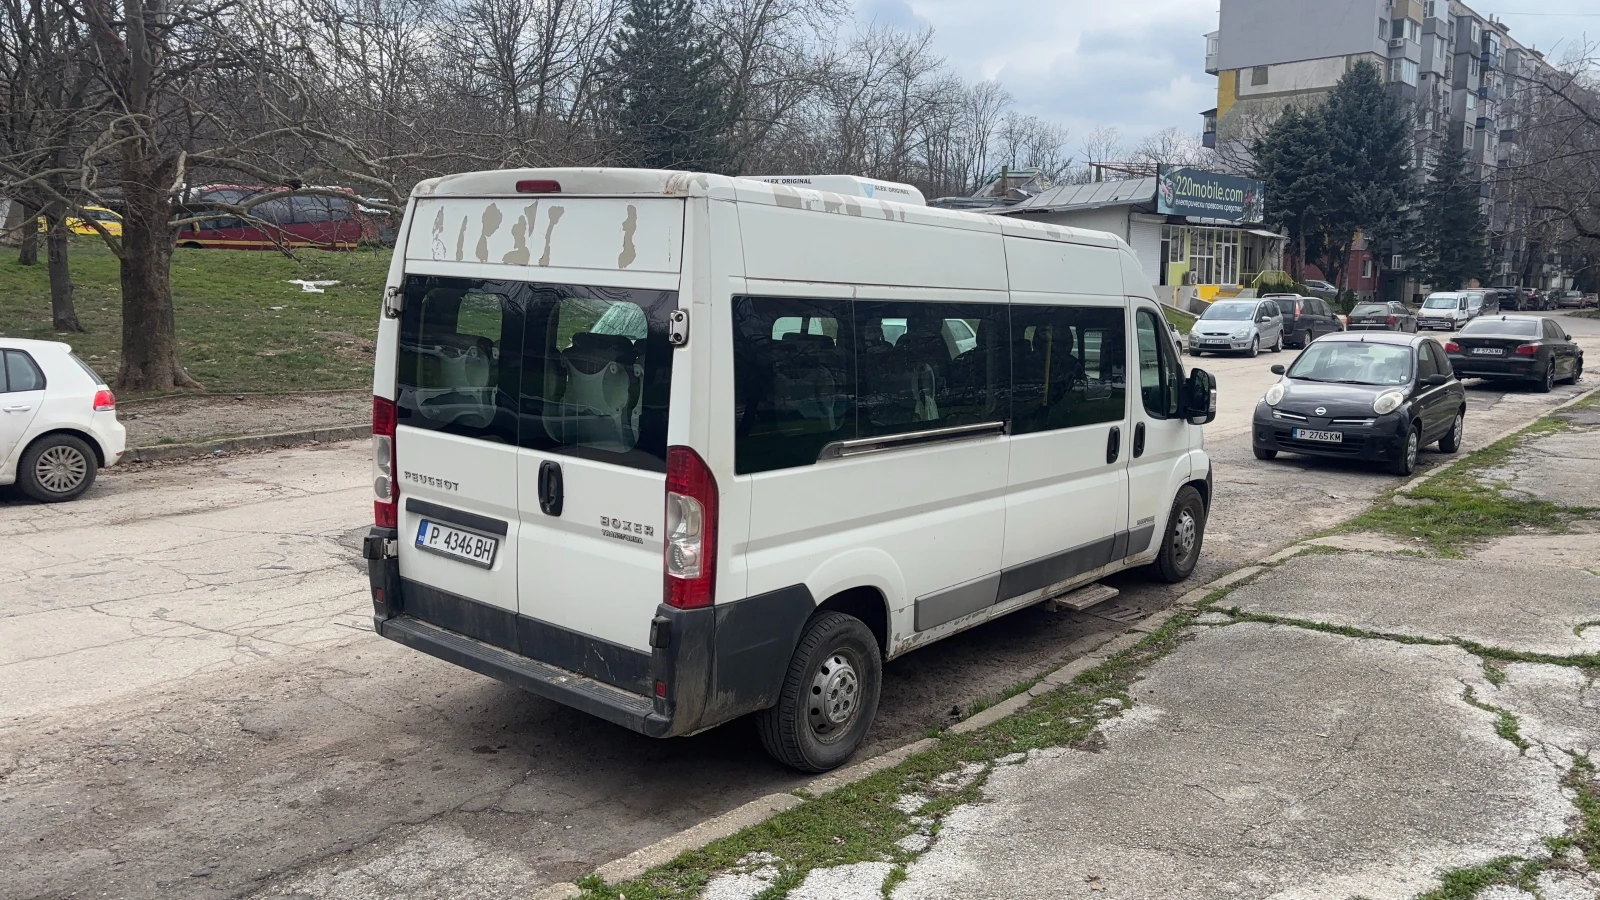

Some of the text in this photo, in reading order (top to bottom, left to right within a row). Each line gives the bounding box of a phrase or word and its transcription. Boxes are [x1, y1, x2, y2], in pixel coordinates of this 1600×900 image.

[1175, 175, 1243, 202] 220mobile.com
[1300, 430, 1306, 438] P
[404, 470, 459, 491] PEUGEOT
[429, 526, 440, 545] P
[600, 515, 654, 537] BOXER
